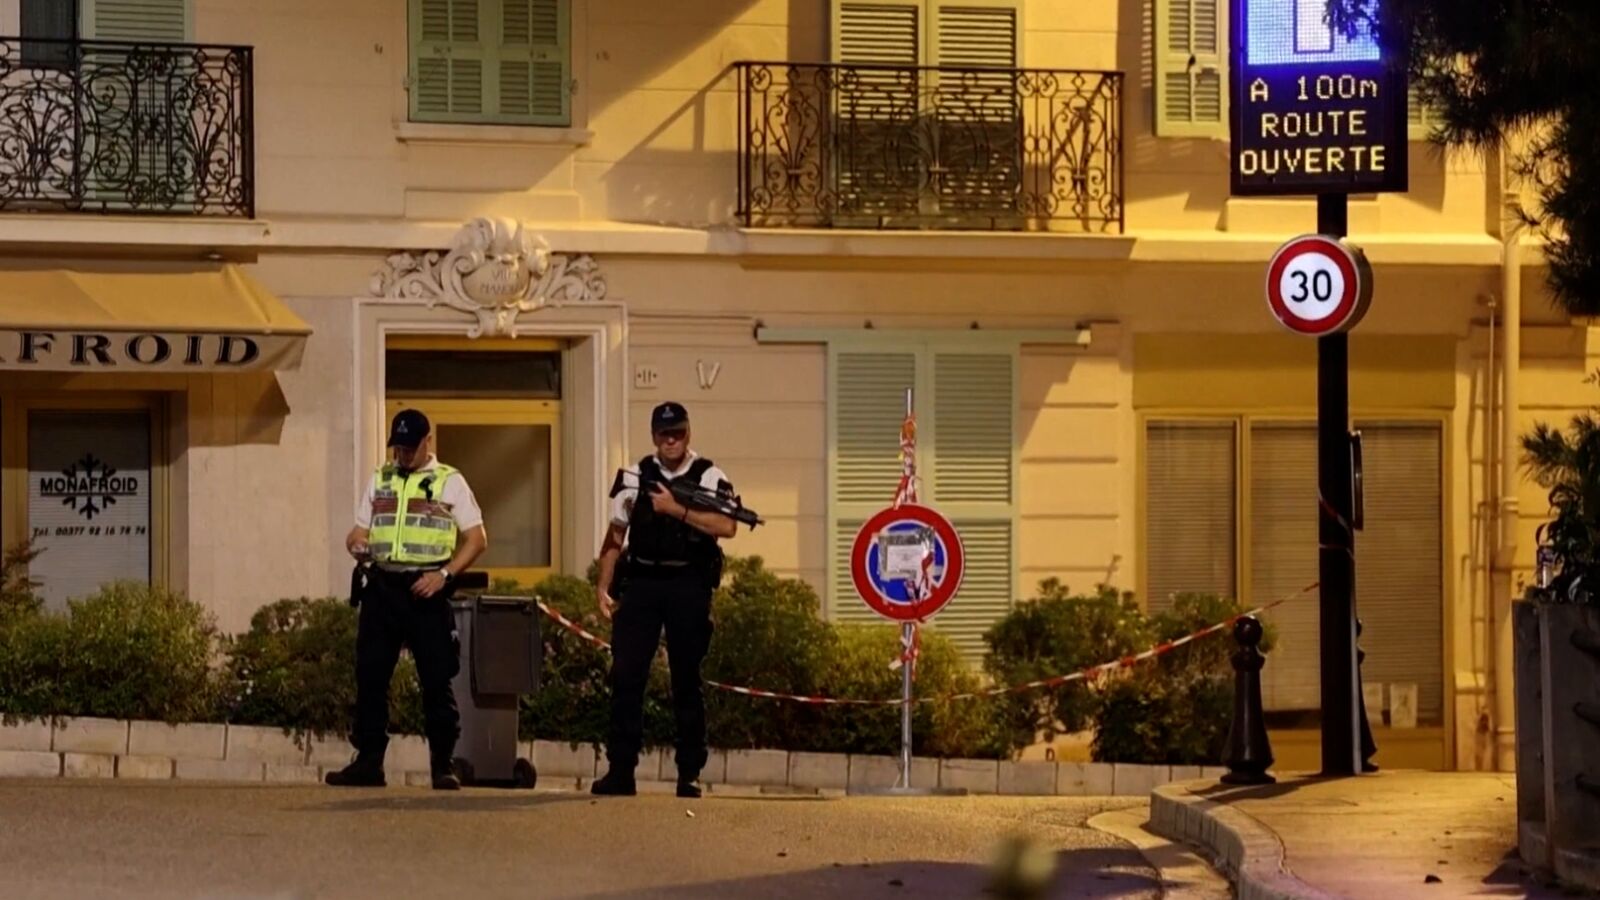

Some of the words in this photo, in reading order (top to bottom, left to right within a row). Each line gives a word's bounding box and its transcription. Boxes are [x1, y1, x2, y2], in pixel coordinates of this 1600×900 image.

[1250, 77, 1269, 102] A
[1297, 74, 1378, 101] 100m
[1261, 110, 1367, 138] ROUTE
[1240, 146, 1385, 174] OUVERTE
[1289, 269, 1332, 303] 30
[0, 331, 259, 366] FROID
[40, 477, 138, 492] MONAFROID
